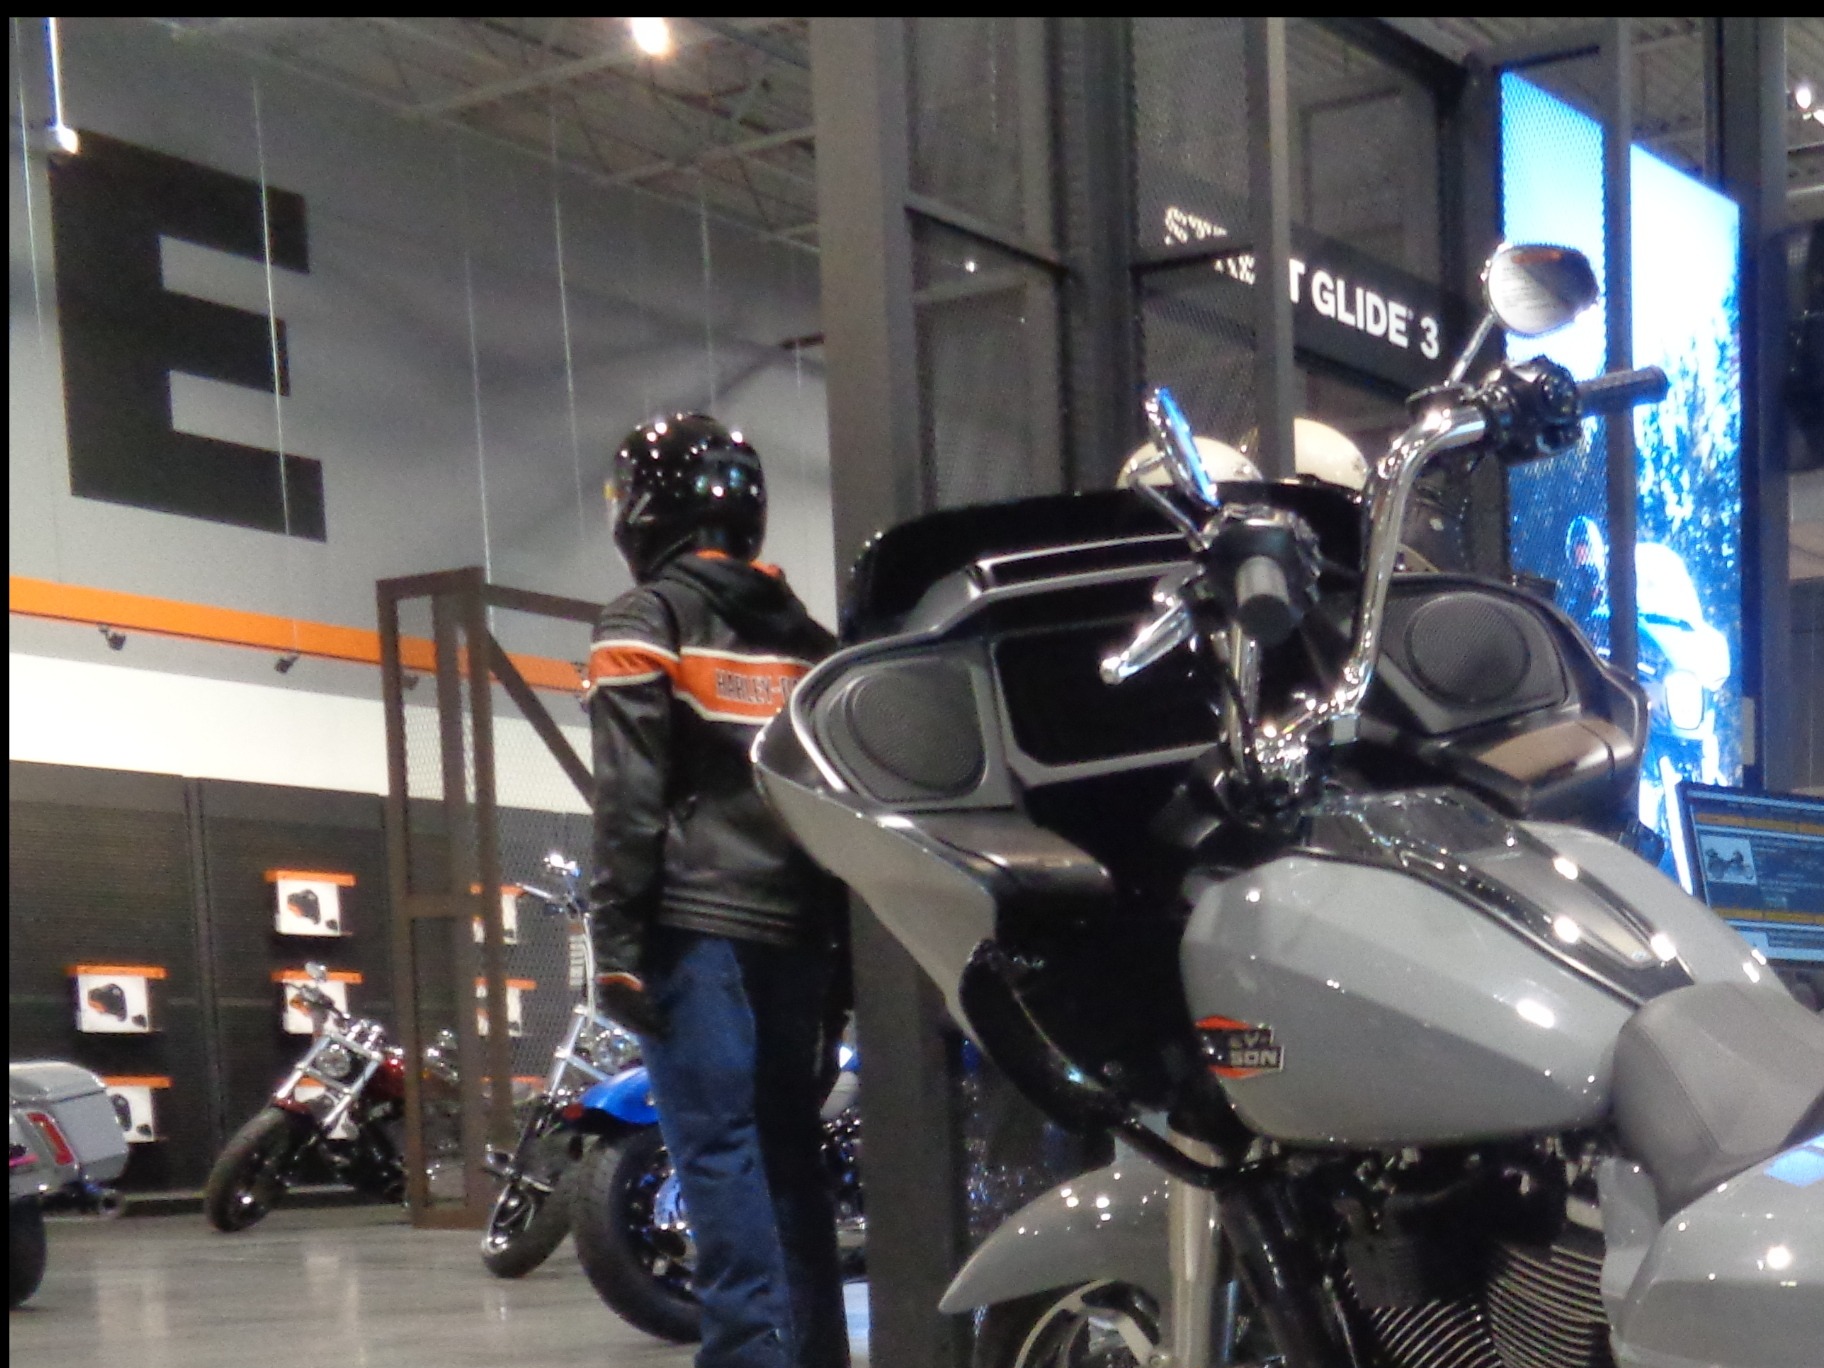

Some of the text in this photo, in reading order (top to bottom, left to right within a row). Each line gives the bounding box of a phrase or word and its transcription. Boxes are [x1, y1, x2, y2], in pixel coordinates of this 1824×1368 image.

[51, 129, 328, 542] E
[1311, 269, 1410, 349] GLIDE
[1420, 316, 1441, 360] 3
